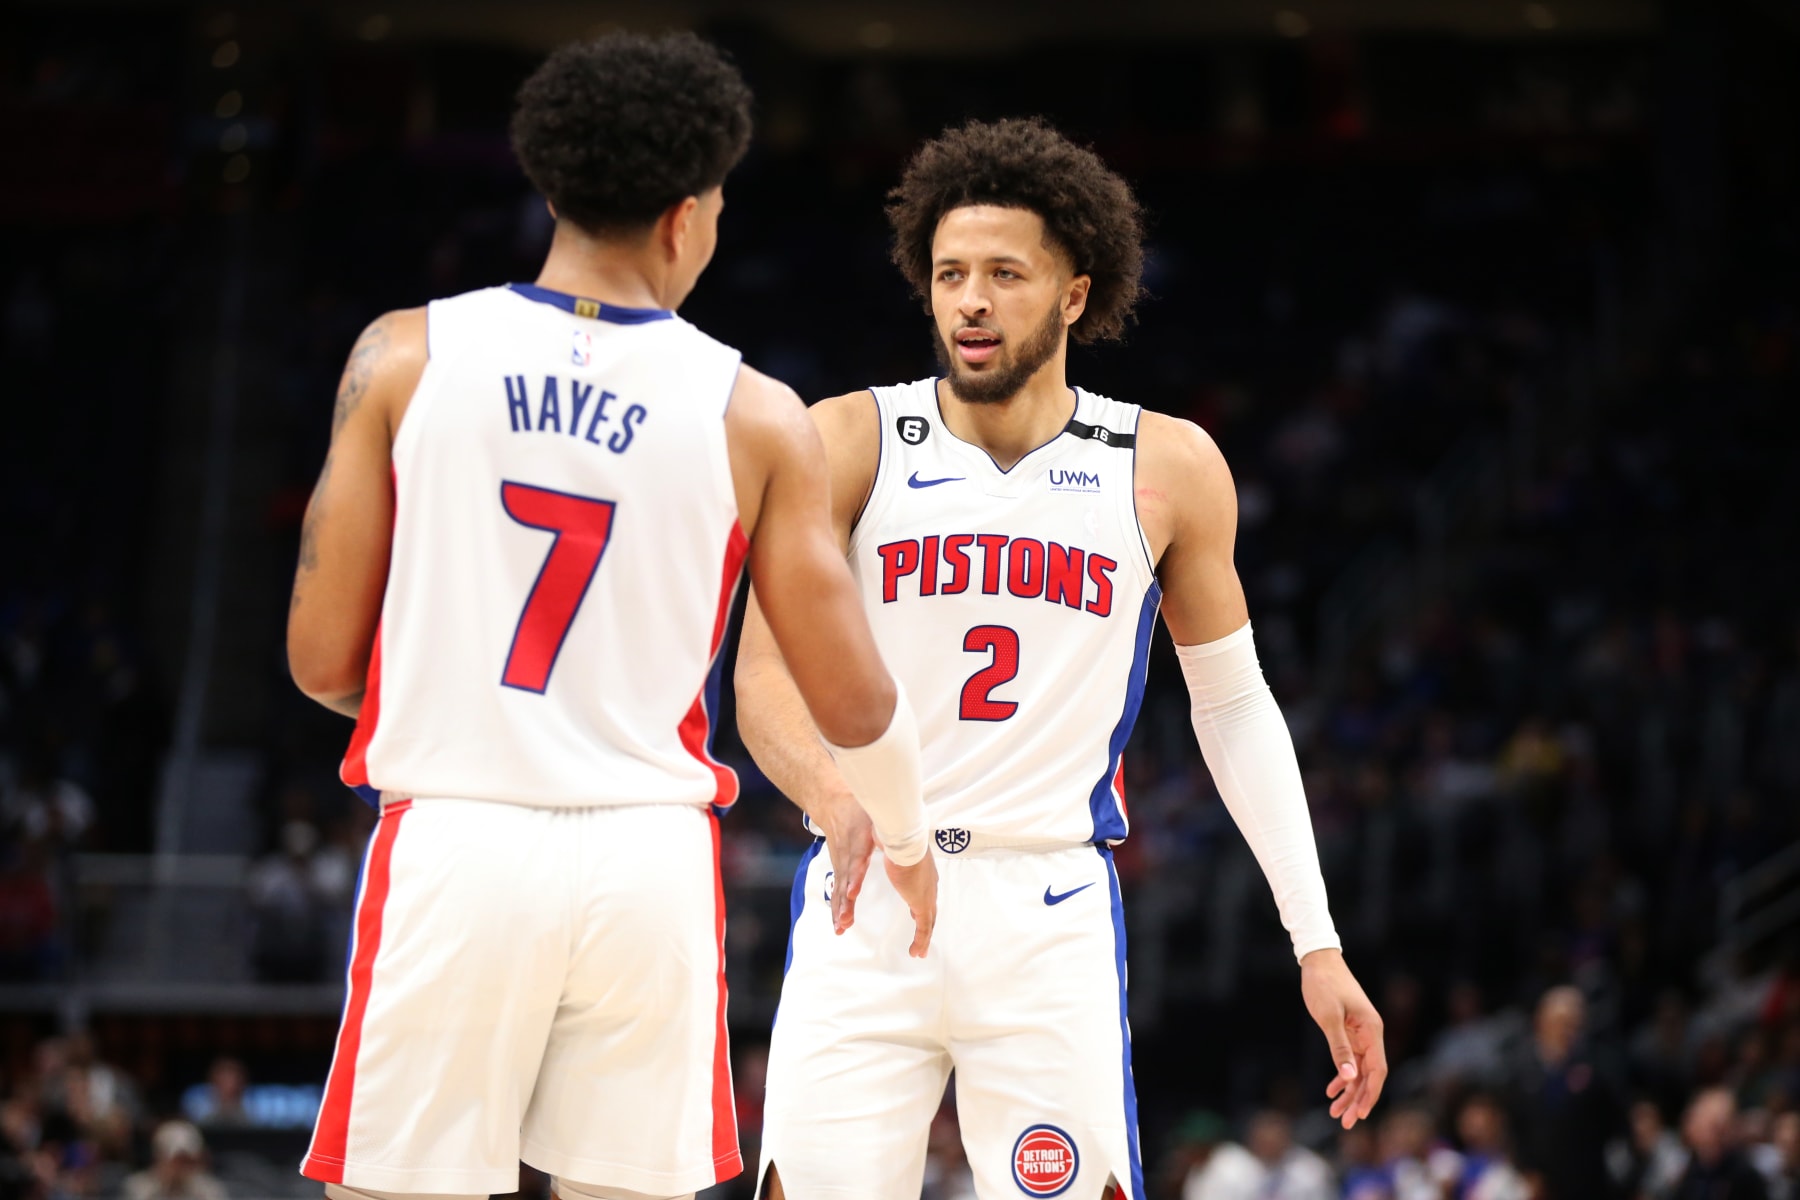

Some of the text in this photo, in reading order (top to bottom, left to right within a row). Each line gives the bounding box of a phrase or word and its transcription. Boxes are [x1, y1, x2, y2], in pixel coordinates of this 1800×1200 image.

[503, 375, 648, 454] HAYES
[902, 419, 922, 442] 6
[1092, 427, 1109, 442] 16
[1049, 469, 1100, 487] UWM
[500, 479, 617, 695] 7
[877, 534, 1118, 618] PISTONS
[958, 624, 1020, 722] 2
[1023, 1148, 1065, 1162] DETROIT
[1023, 1160, 1066, 1174] PISTONS
